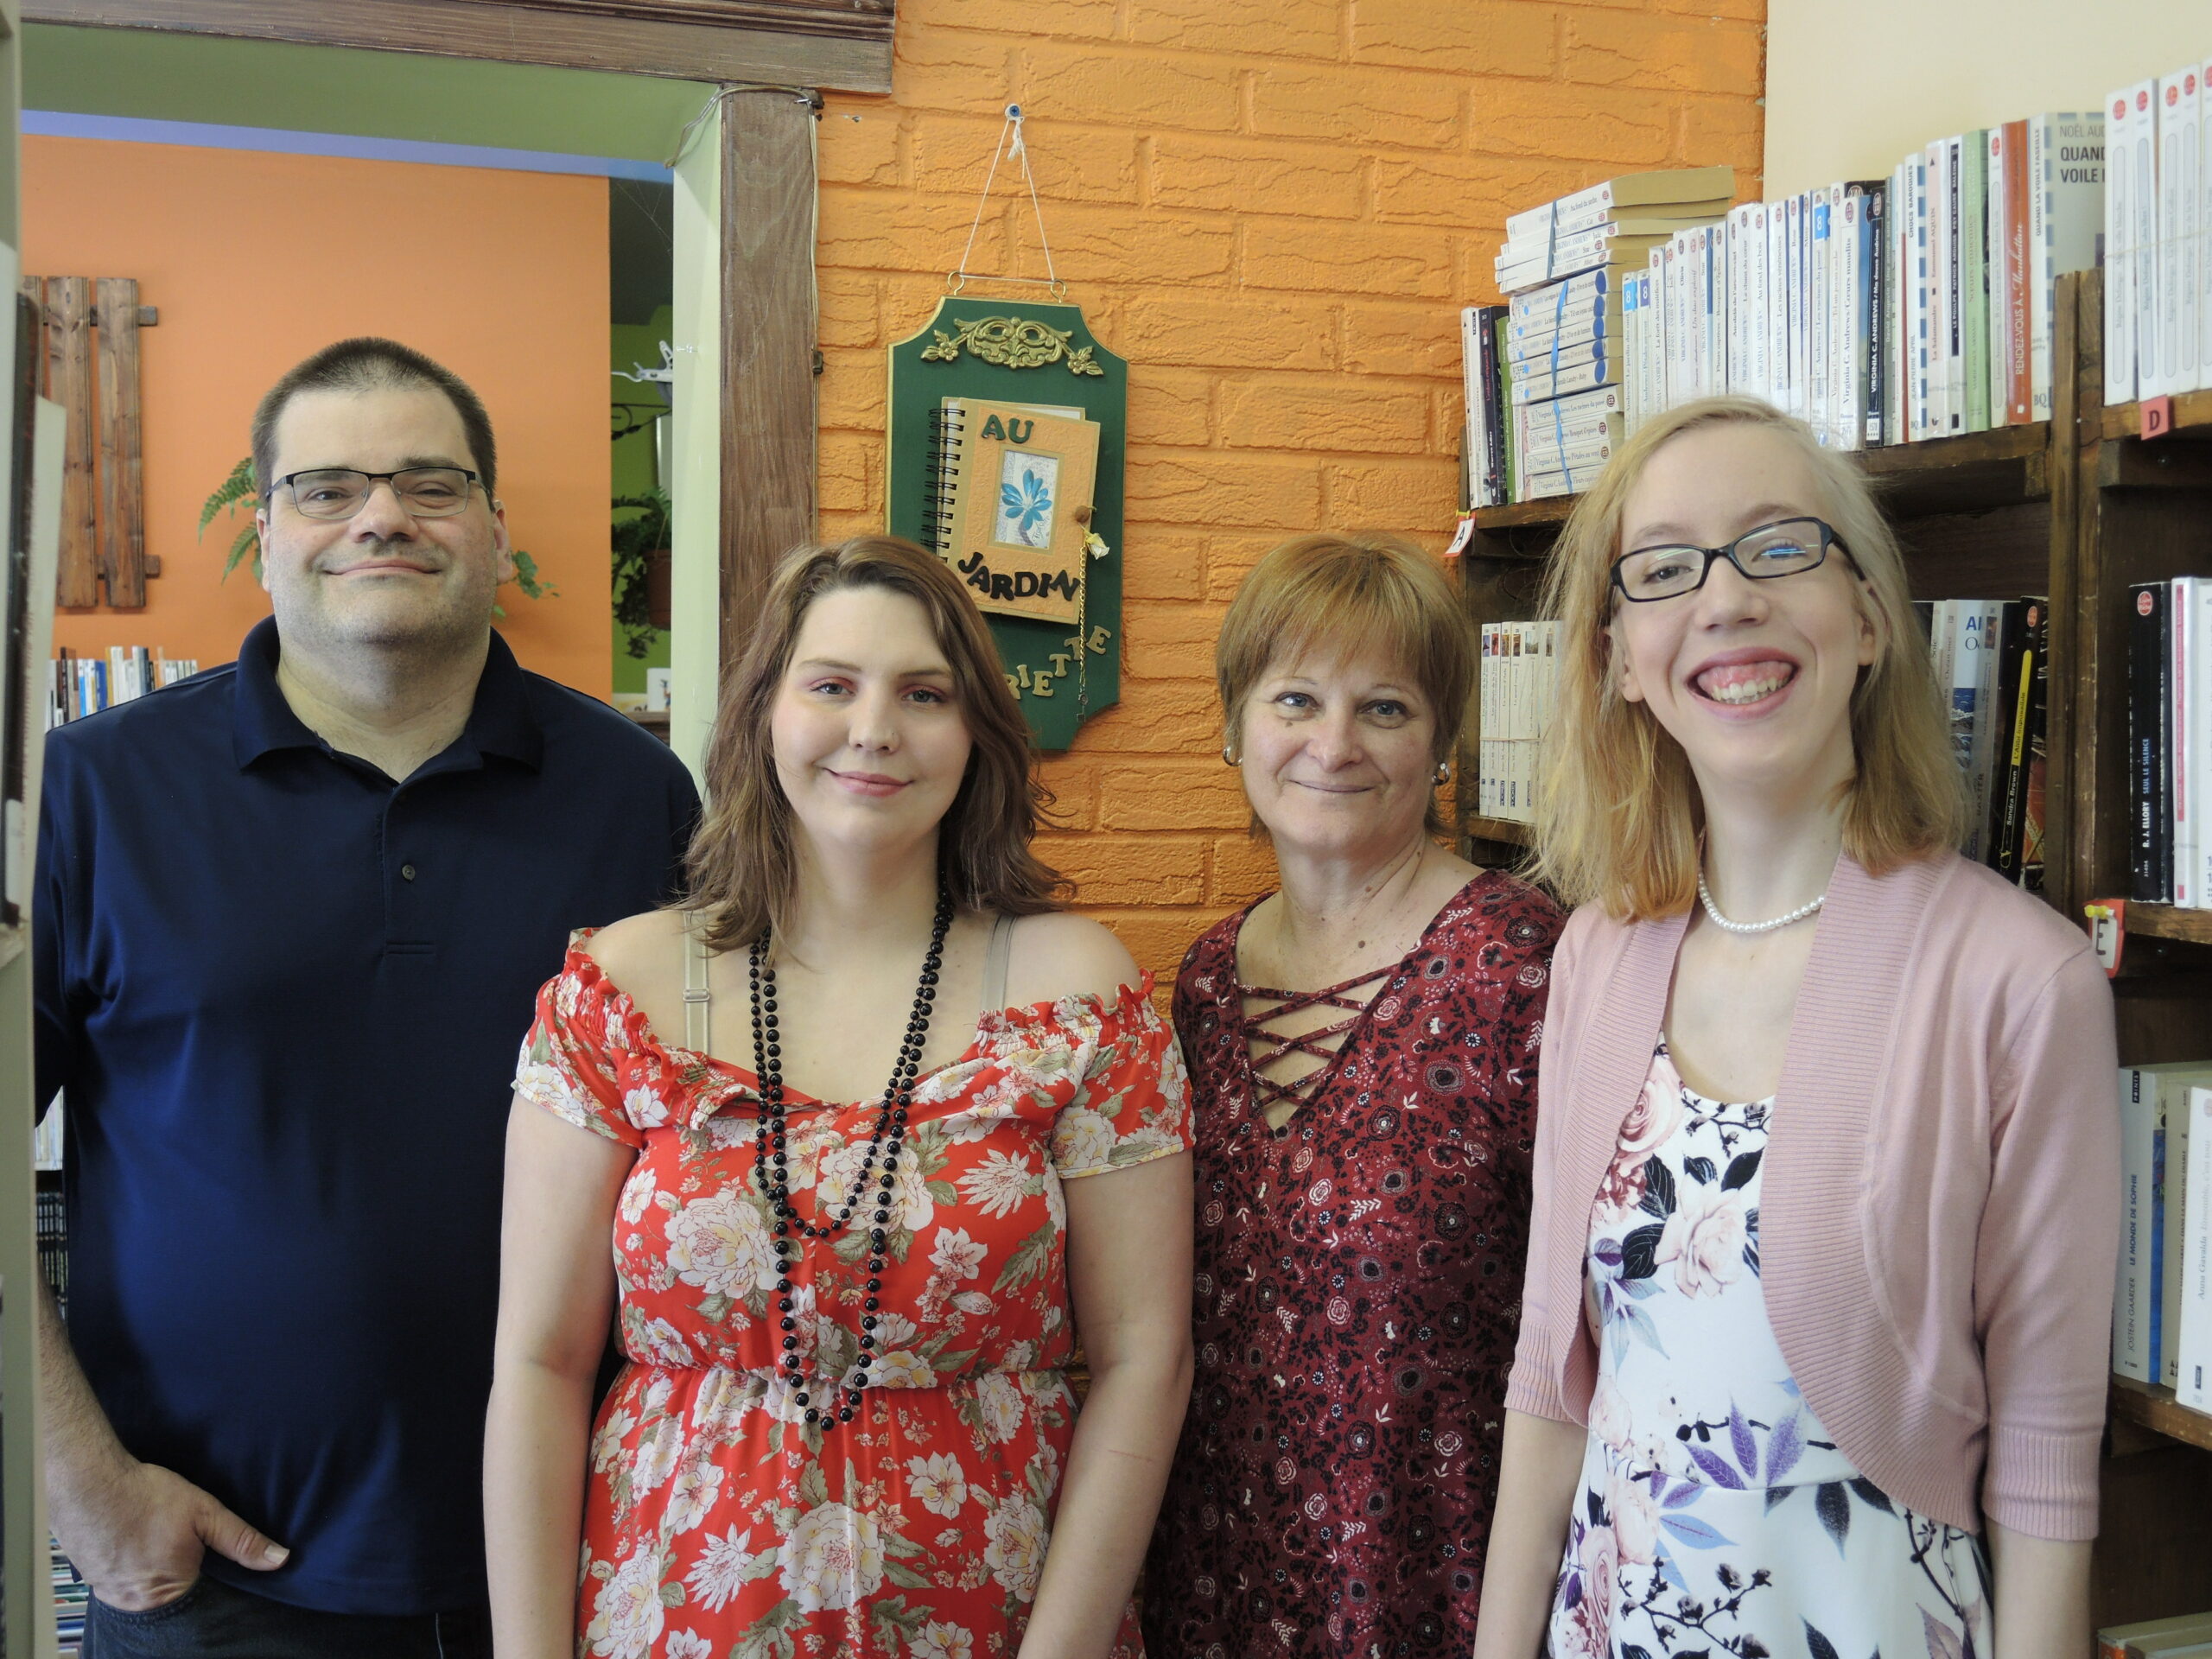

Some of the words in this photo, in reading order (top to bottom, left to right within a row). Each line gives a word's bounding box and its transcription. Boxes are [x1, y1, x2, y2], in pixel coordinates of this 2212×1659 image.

[2060, 124, 2084, 137] NOËL
[2060, 168, 2098, 183] VOILE
[1873, 282, 1878, 294] Ma
[2015, 309, 2024, 375] RENDEZ-VOUS
[1842, 366, 1852, 404] Virginia
[981, 414, 1033, 443] AU
[2148, 410, 2160, 432] D
[1452, 526, 1465, 548] A
[957, 551, 1080, 602] JARDIN
[2008, 770, 2018, 796] Brown
[2005, 798, 2015, 826] Sandra
[2143, 839, 2150, 848] R.
[2095, 918, 2109, 956] E
[2129, 1174, 2138, 1205] SOPHIE
[2129, 1208, 2137, 1219] DE
[2128, 1256, 2136, 1266] LE
[2198, 1236, 2208, 1273] Gavalda
[2197, 1275, 2206, 1300] Anna
[2126, 1319, 2136, 1352] JOSTEIN
